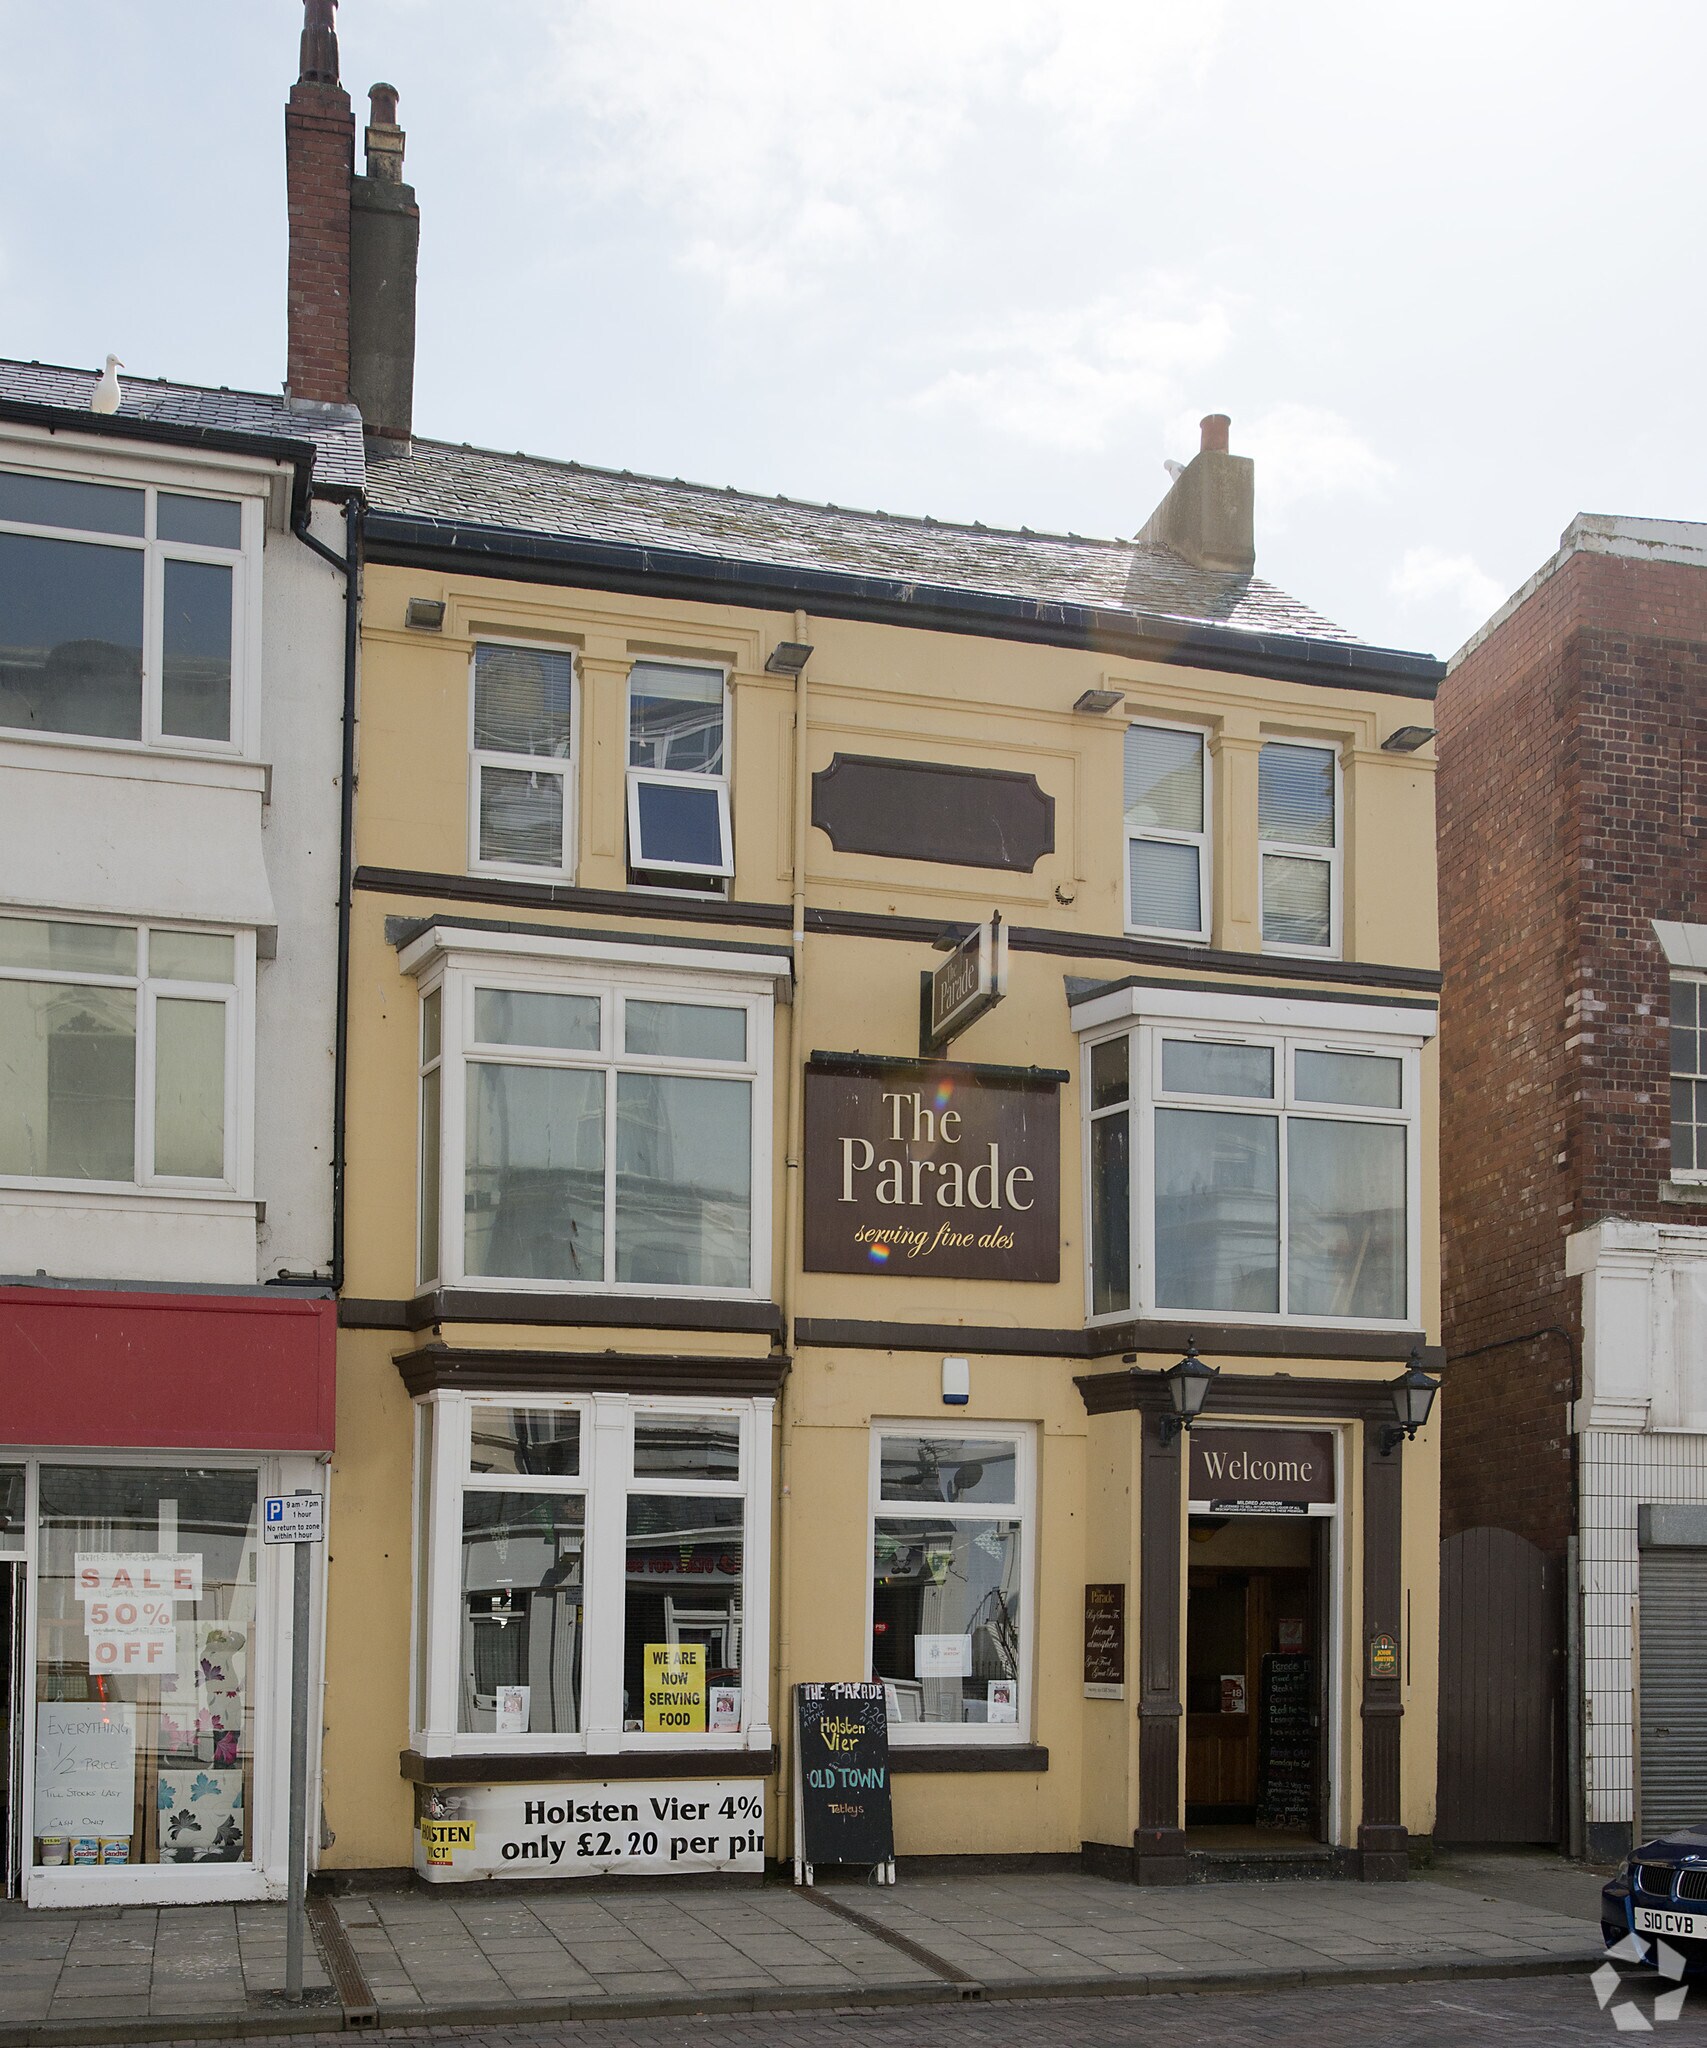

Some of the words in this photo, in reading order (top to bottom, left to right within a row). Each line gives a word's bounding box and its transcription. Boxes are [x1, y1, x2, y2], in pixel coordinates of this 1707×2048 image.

[940, 958, 975, 1015] Parade
[882, 1092, 962, 1144] The
[837, 1137, 1035, 1212] Parade
[854, 1225, 929, 1258] serving
[922, 1221, 974, 1255] fine
[978, 1225, 1014, 1249] ales
[1202, 1451, 1312, 1482] Welcome
[271, 1502, 280, 1519] P
[80, 1568, 193, 1590] SALE
[1092, 1590, 1115, 1603] Parade
[90, 1603, 170, 1626] 50%
[95, 1642, 164, 1664] OFF
[653, 1652, 670, 1665] WE
[674, 1652, 696, 1665] ARE
[662, 1672, 688, 1685] NOW
[649, 1692, 700, 1706] SERVING
[801, 1684, 825, 1700] THE
[831, 1683, 883, 1700] PARADE
[48, 1715, 128, 1736] EVERYTHING
[660, 1712, 690, 1726] FOOD
[820, 1716, 865, 1734] Holsten
[821, 1732, 859, 1751] Vier
[85, 1758, 119, 1770] PRICE
[809, 1769, 836, 1789] OLD
[838, 1768, 885, 1789] TOWN
[524, 1799, 638, 1824] Holsten
[649, 1797, 709, 1821] Vier
[718, 1796, 762, 1820] 4%
[828, 1803, 864, 1817] Tetleys
[502, 1834, 566, 1865] only
[670, 1836, 719, 1860] per
[1644, 1911, 1662, 1930] S10
[1665, 1914, 1693, 1934] CVB
